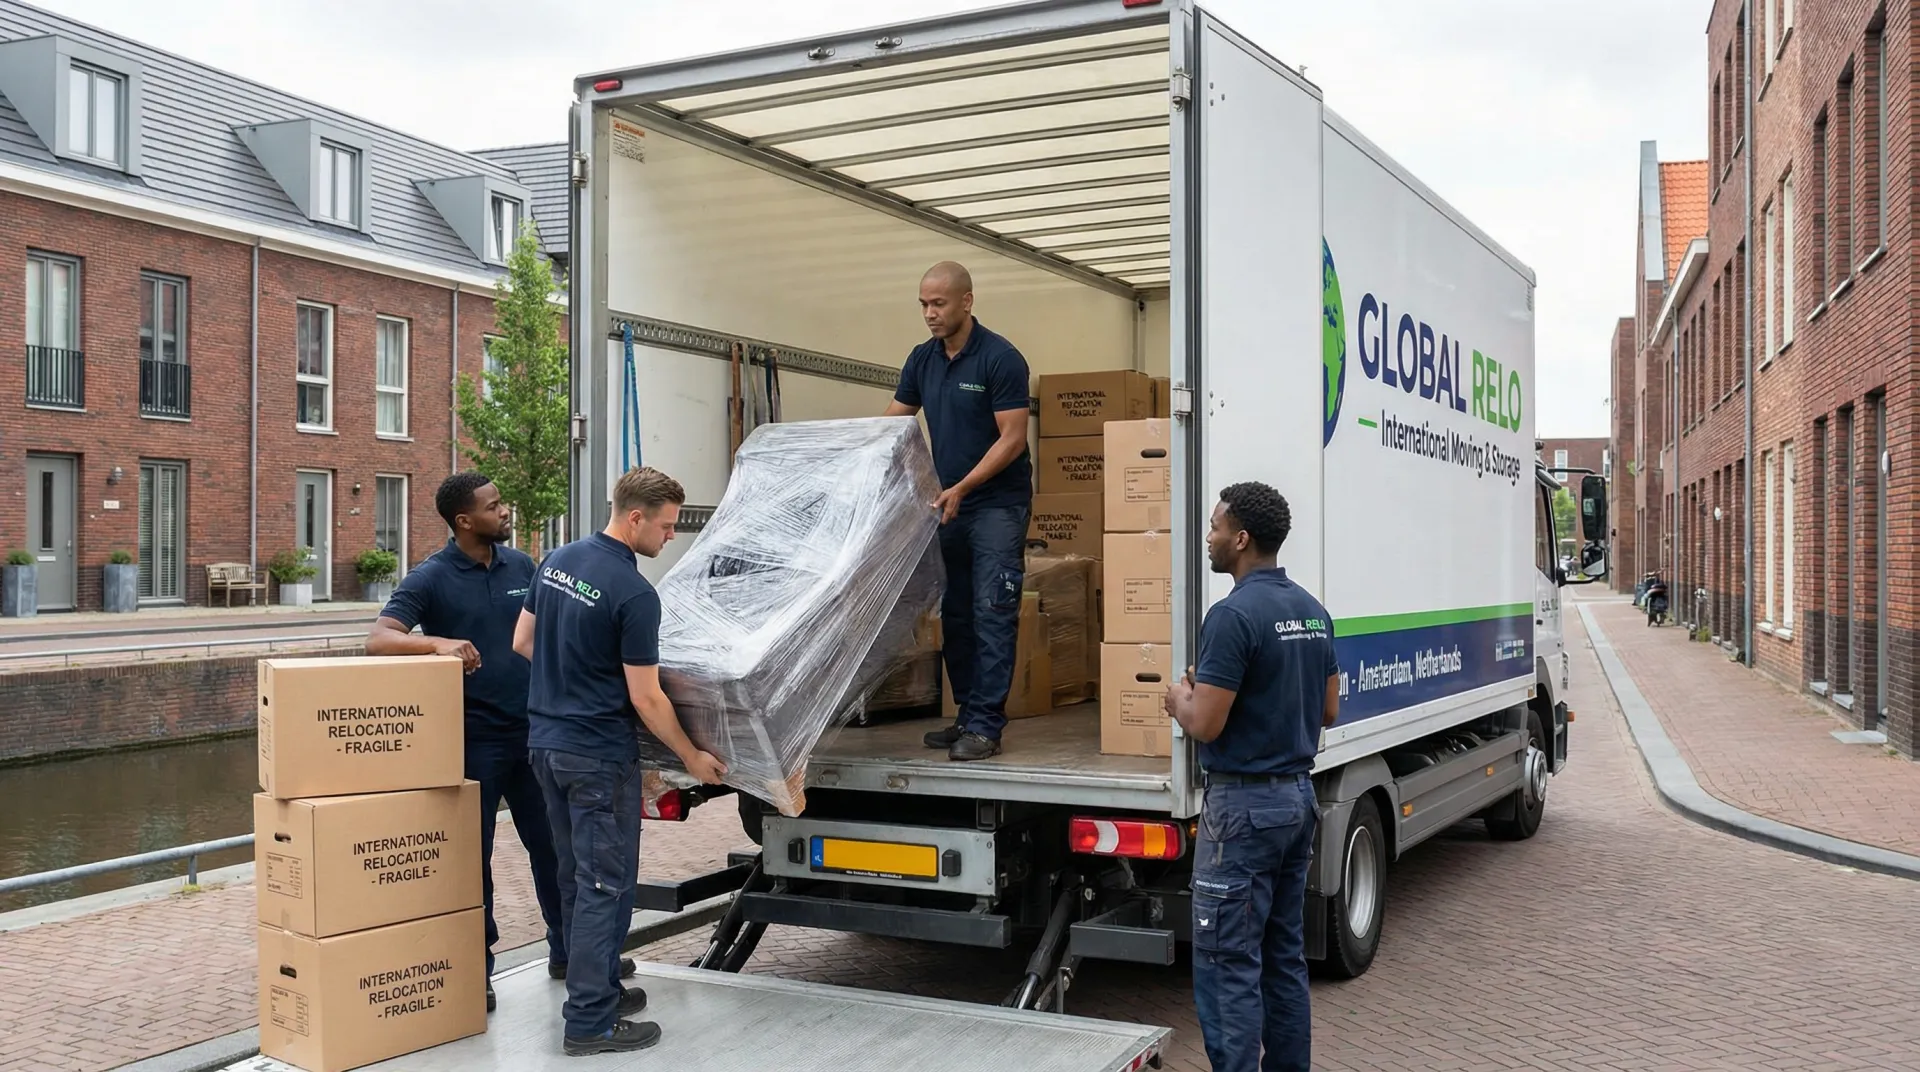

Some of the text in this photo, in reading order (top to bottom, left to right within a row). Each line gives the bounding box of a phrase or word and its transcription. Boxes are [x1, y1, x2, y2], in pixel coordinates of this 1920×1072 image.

[1358, 292, 1522, 433] GLOBAL RELO
[1382, 409, 1520, 486] International Moving & Storage
[544, 567, 575, 588] GLOBAL
[575, 580, 601, 599] RELO
[1358, 654, 1413, 692] Amsterdam,
[1416, 644, 1461, 680] Netherlands
[317, 705, 424, 721] INTERNATIONAL
[328, 722, 414, 738] RELOCATION
[345, 739, 402, 754] FRAGILE
[354, 830, 448, 855] INTERNATIONAL
[364, 848, 439, 871] RELOCATION
[379, 866, 430, 885] FRAGILE
[360, 959, 452, 990] INTERNATIONAL
[369, 976, 444, 1005] RELOCATION
[384, 996, 435, 1018] FRAGILE
